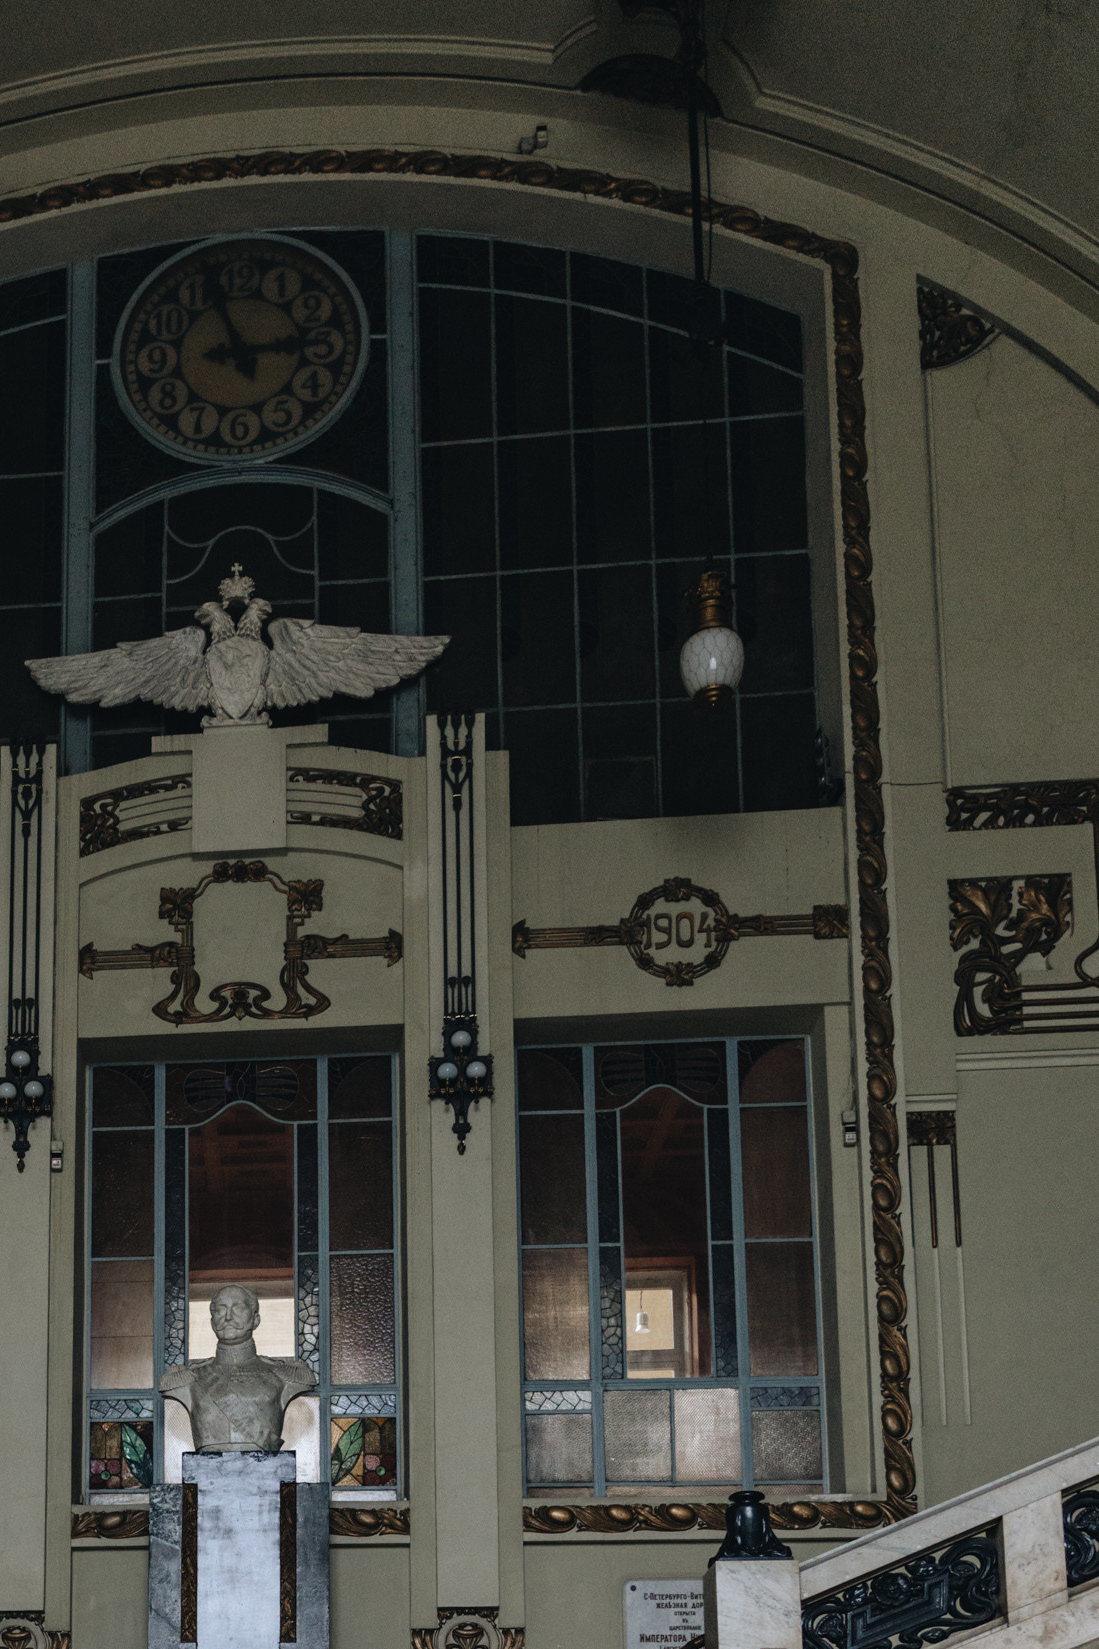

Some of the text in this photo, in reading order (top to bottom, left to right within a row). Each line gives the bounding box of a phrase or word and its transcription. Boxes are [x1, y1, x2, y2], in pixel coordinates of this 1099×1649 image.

[225, 263, 253, 295] 12
[276, 271, 287, 299] 1
[156, 306, 184, 336] 10
[303, 294, 322, 324] 2
[312, 330, 335, 360] 3
[146, 346, 168, 375] 9
[159, 381, 177, 410] 8
[301, 370, 326, 398] 4
[189, 405, 207, 435] 7
[230, 413, 249, 441] 6
[272, 399, 293, 428] 5
[642, 911, 716, 951] 1904
[644, 1592, 704, 1600] С-ПЕТЕРБУРГО-ВИТ
